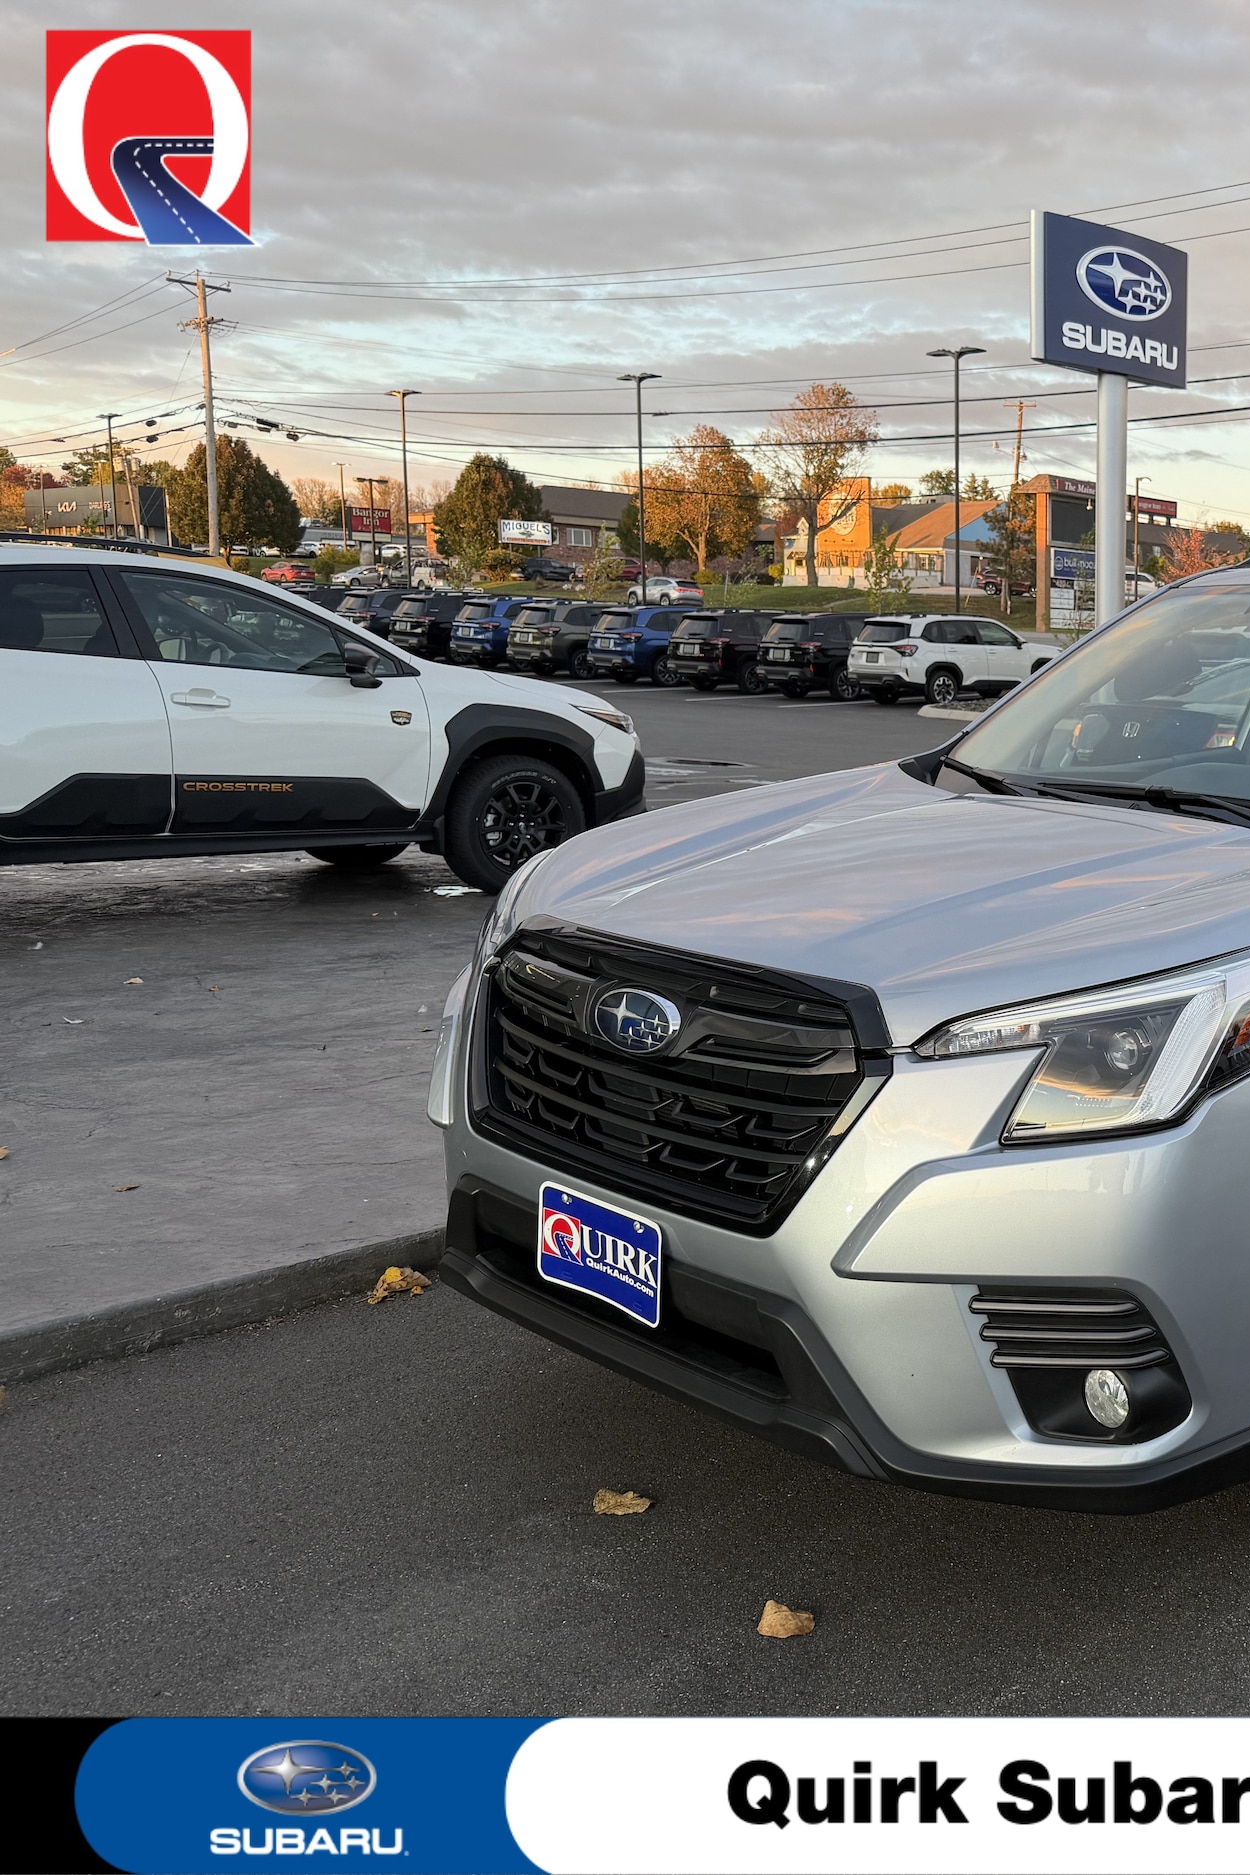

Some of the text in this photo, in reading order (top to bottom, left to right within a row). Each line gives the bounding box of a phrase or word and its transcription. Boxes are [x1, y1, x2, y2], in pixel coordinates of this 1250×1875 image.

[1062, 322, 1179, 371] SUBARU
[1064, 481, 1077, 491] The
[352, 507, 389, 519] Bangor
[502, 521, 551, 535] MIGUEL'S
[183, 782, 294, 792] CROSSTREK
[543, 1213, 658, 1289] QUIRK
[585, 1258, 655, 1298] QuirkAuto.com
